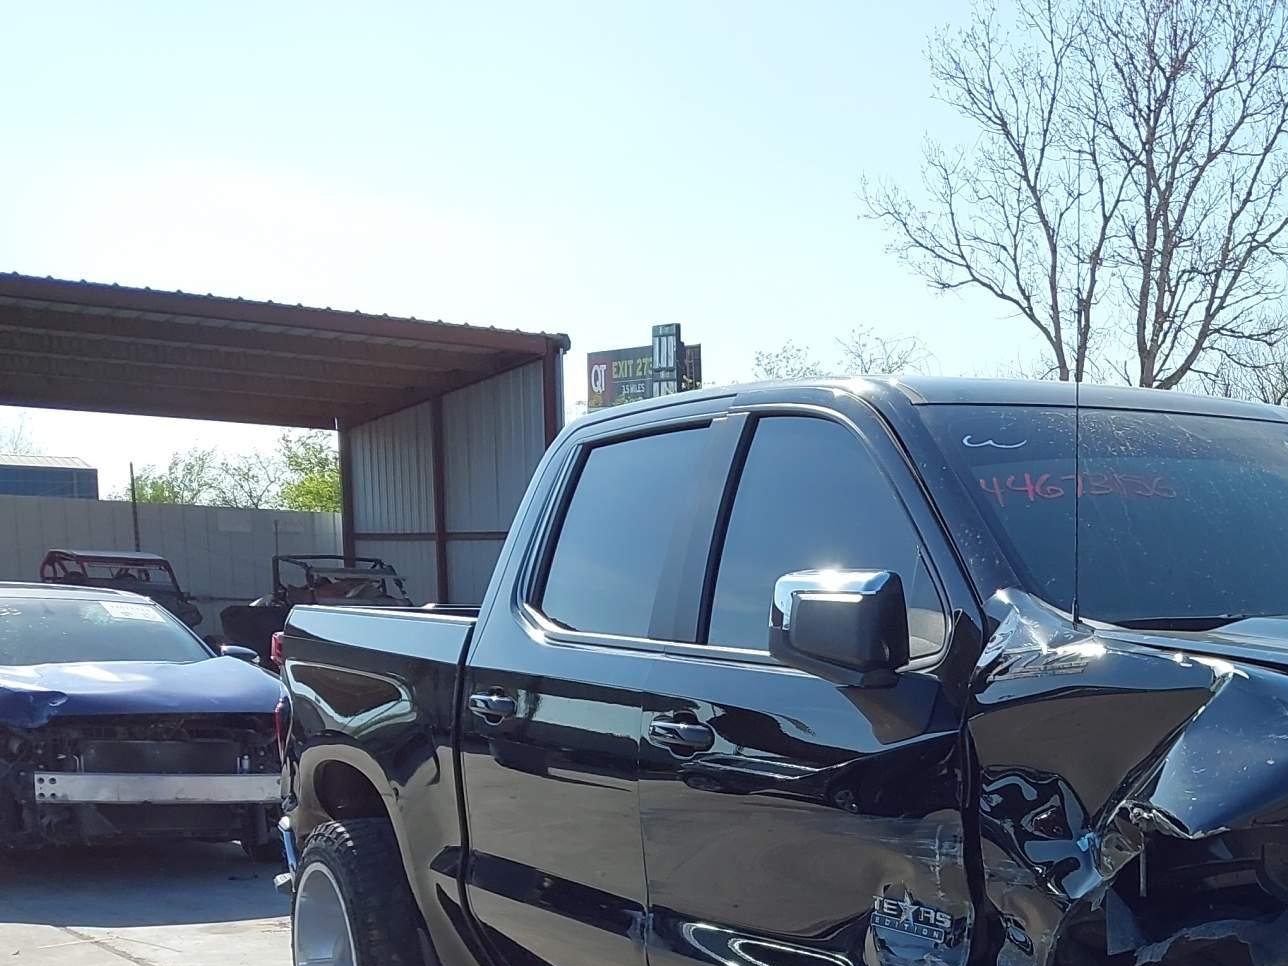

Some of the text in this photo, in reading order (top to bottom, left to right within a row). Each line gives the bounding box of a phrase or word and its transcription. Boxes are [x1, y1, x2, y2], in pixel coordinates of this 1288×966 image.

[591, 364, 607, 393] QT
[612, 360, 633, 379] EXIT
[979, 472, 1176, 507] 44673156
[874, 916, 940, 938] EDITION
